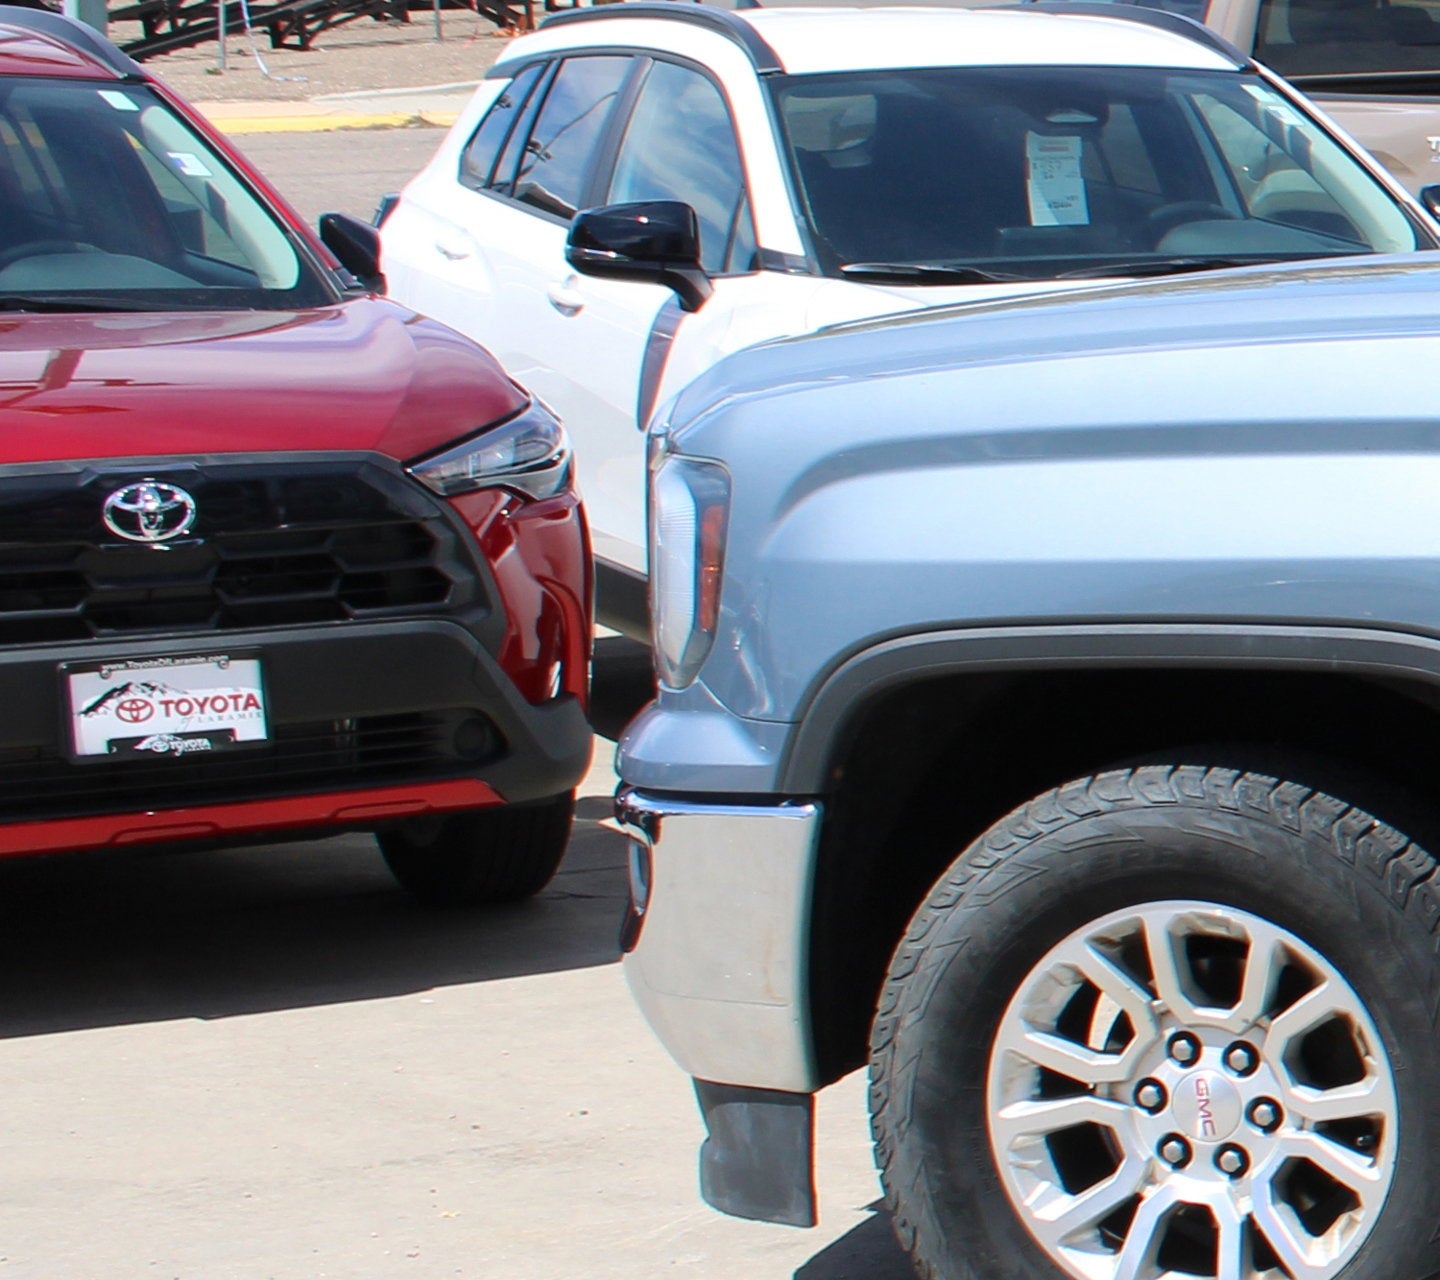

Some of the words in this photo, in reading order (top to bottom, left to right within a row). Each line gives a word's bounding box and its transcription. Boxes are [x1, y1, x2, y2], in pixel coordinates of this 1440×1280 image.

[158, 693, 262, 718] TOYOTA
[198, 711, 263, 724] LARAMIE
[1195, 1078, 1217, 1137] GMC
